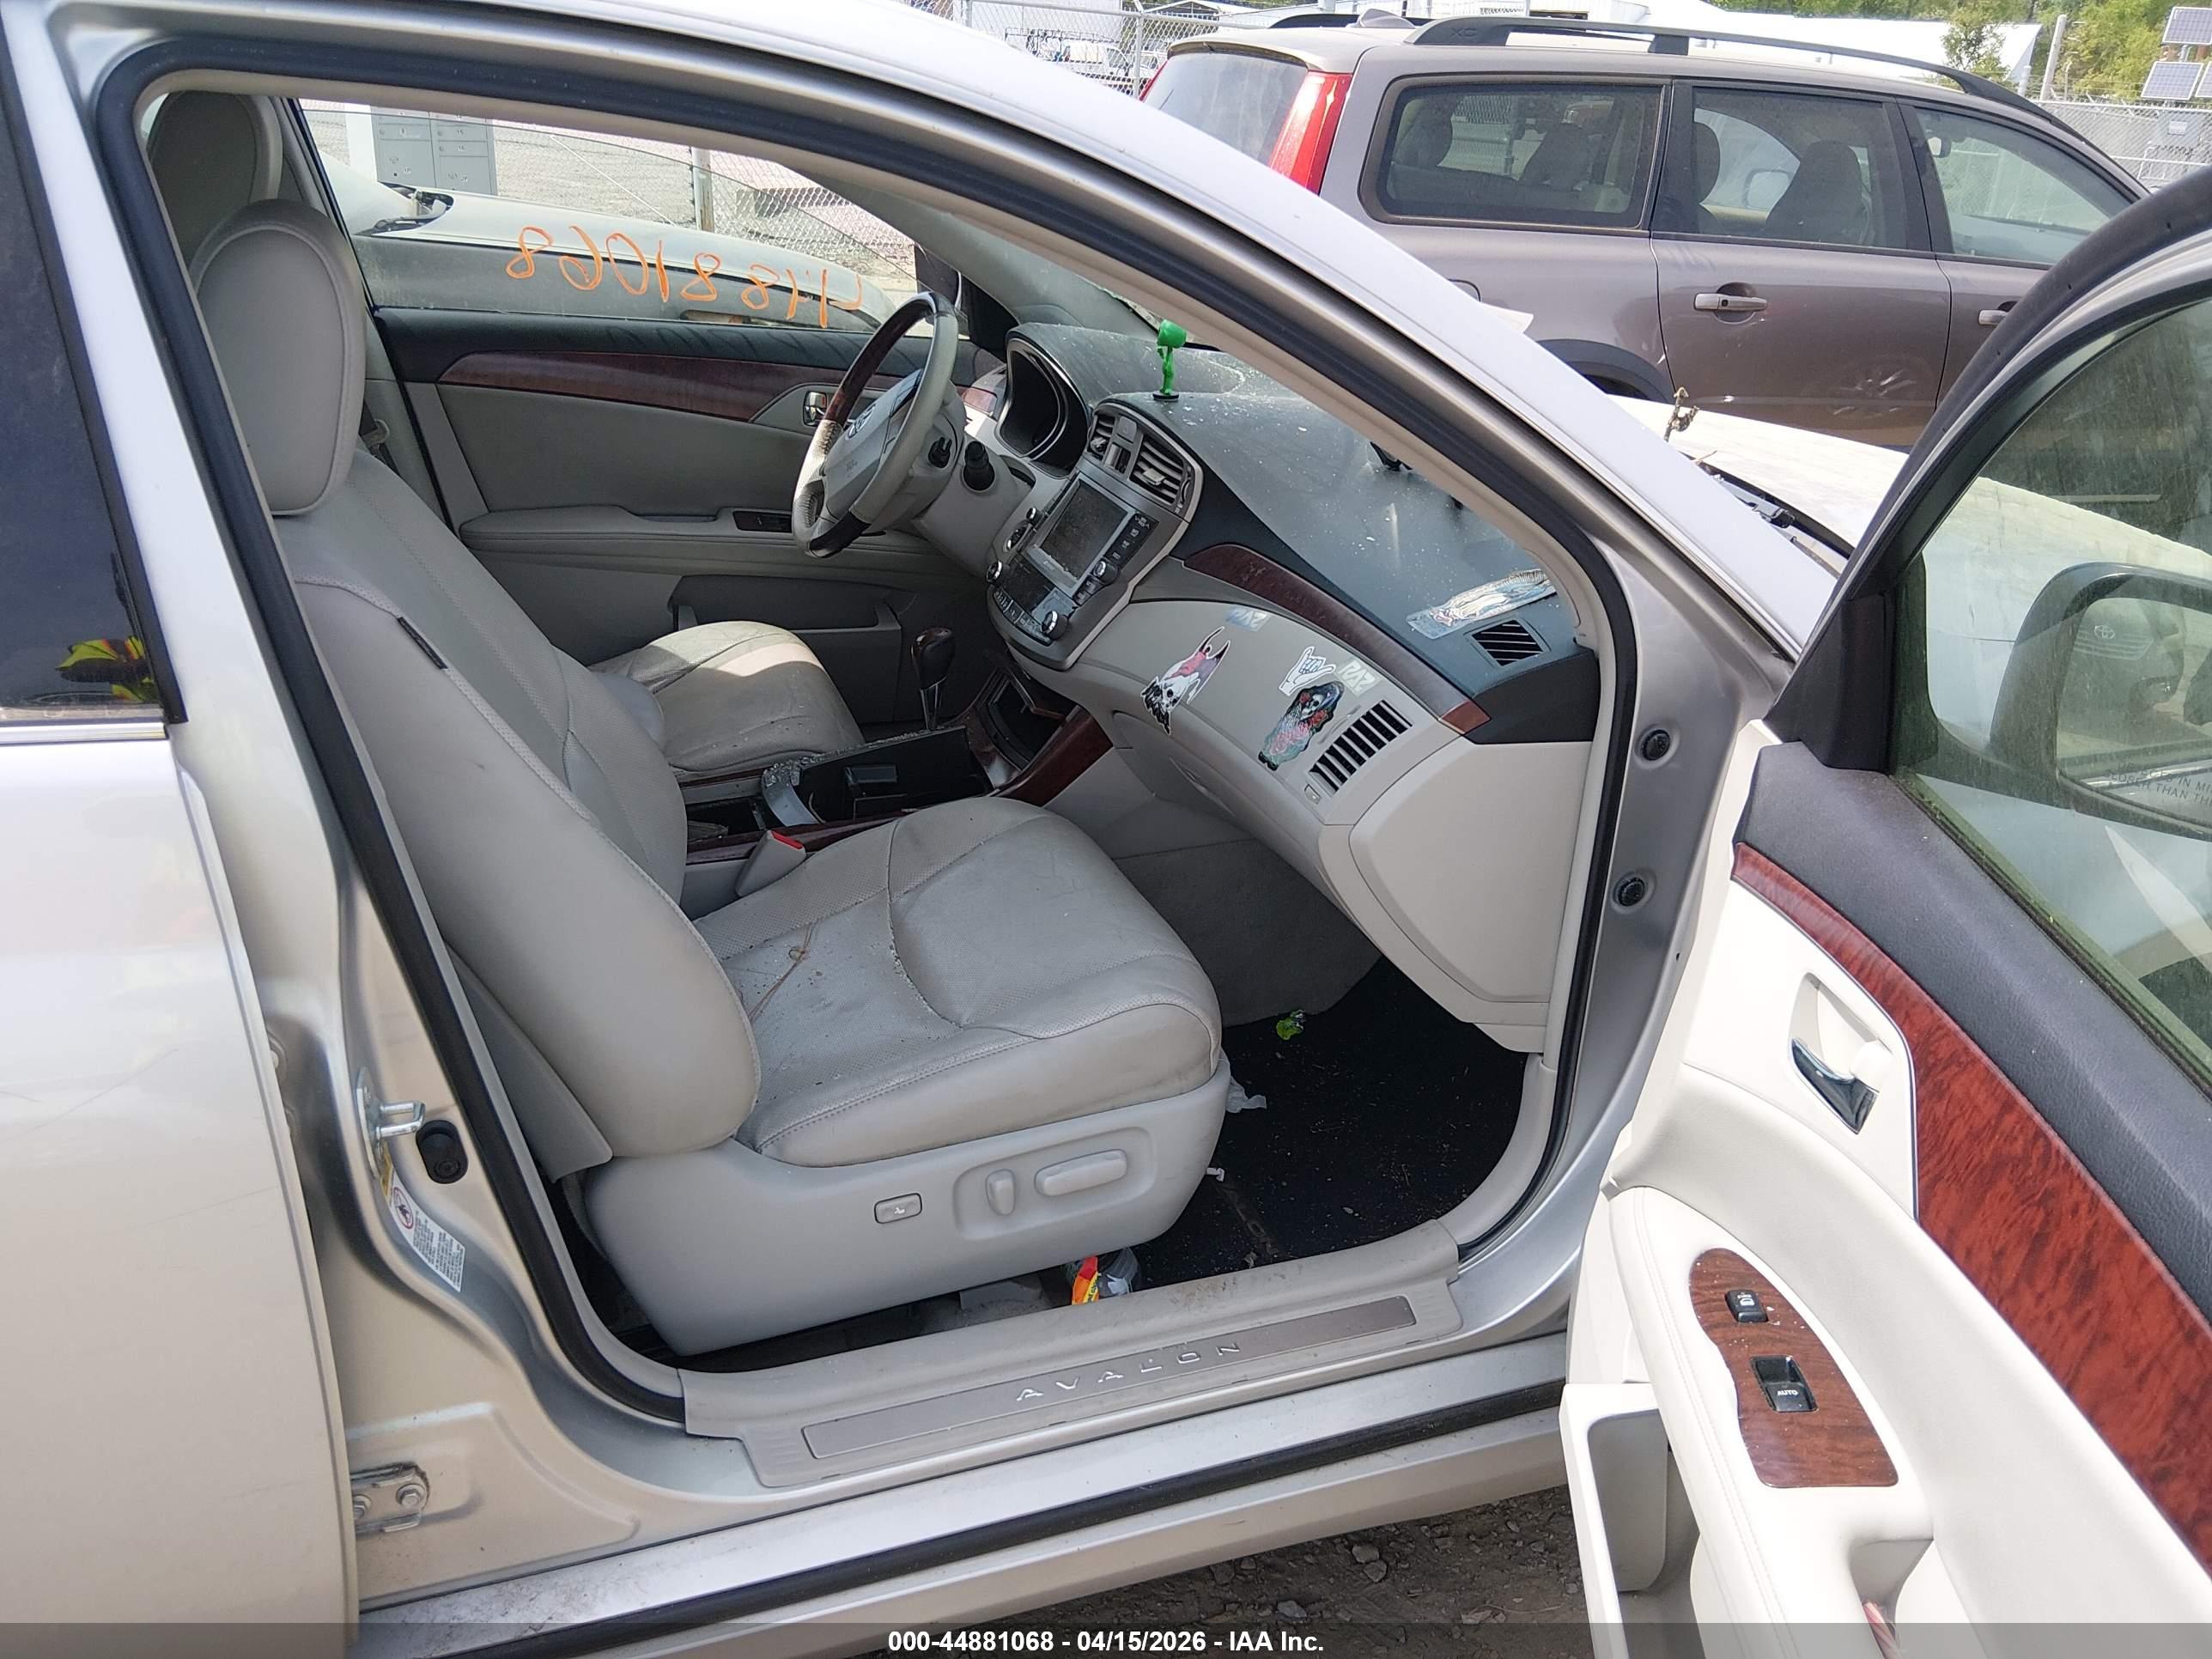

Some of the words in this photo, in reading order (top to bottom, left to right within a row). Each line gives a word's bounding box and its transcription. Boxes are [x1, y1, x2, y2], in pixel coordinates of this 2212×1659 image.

[1449, 27, 1478, 39] XC
[2156, 782, 2188, 799] THAN
[2195, 781, 2212, 794] MI
[1015, 1341, 1241, 1402] AVALON
[1777, 1389, 1799, 1397] AUTO
